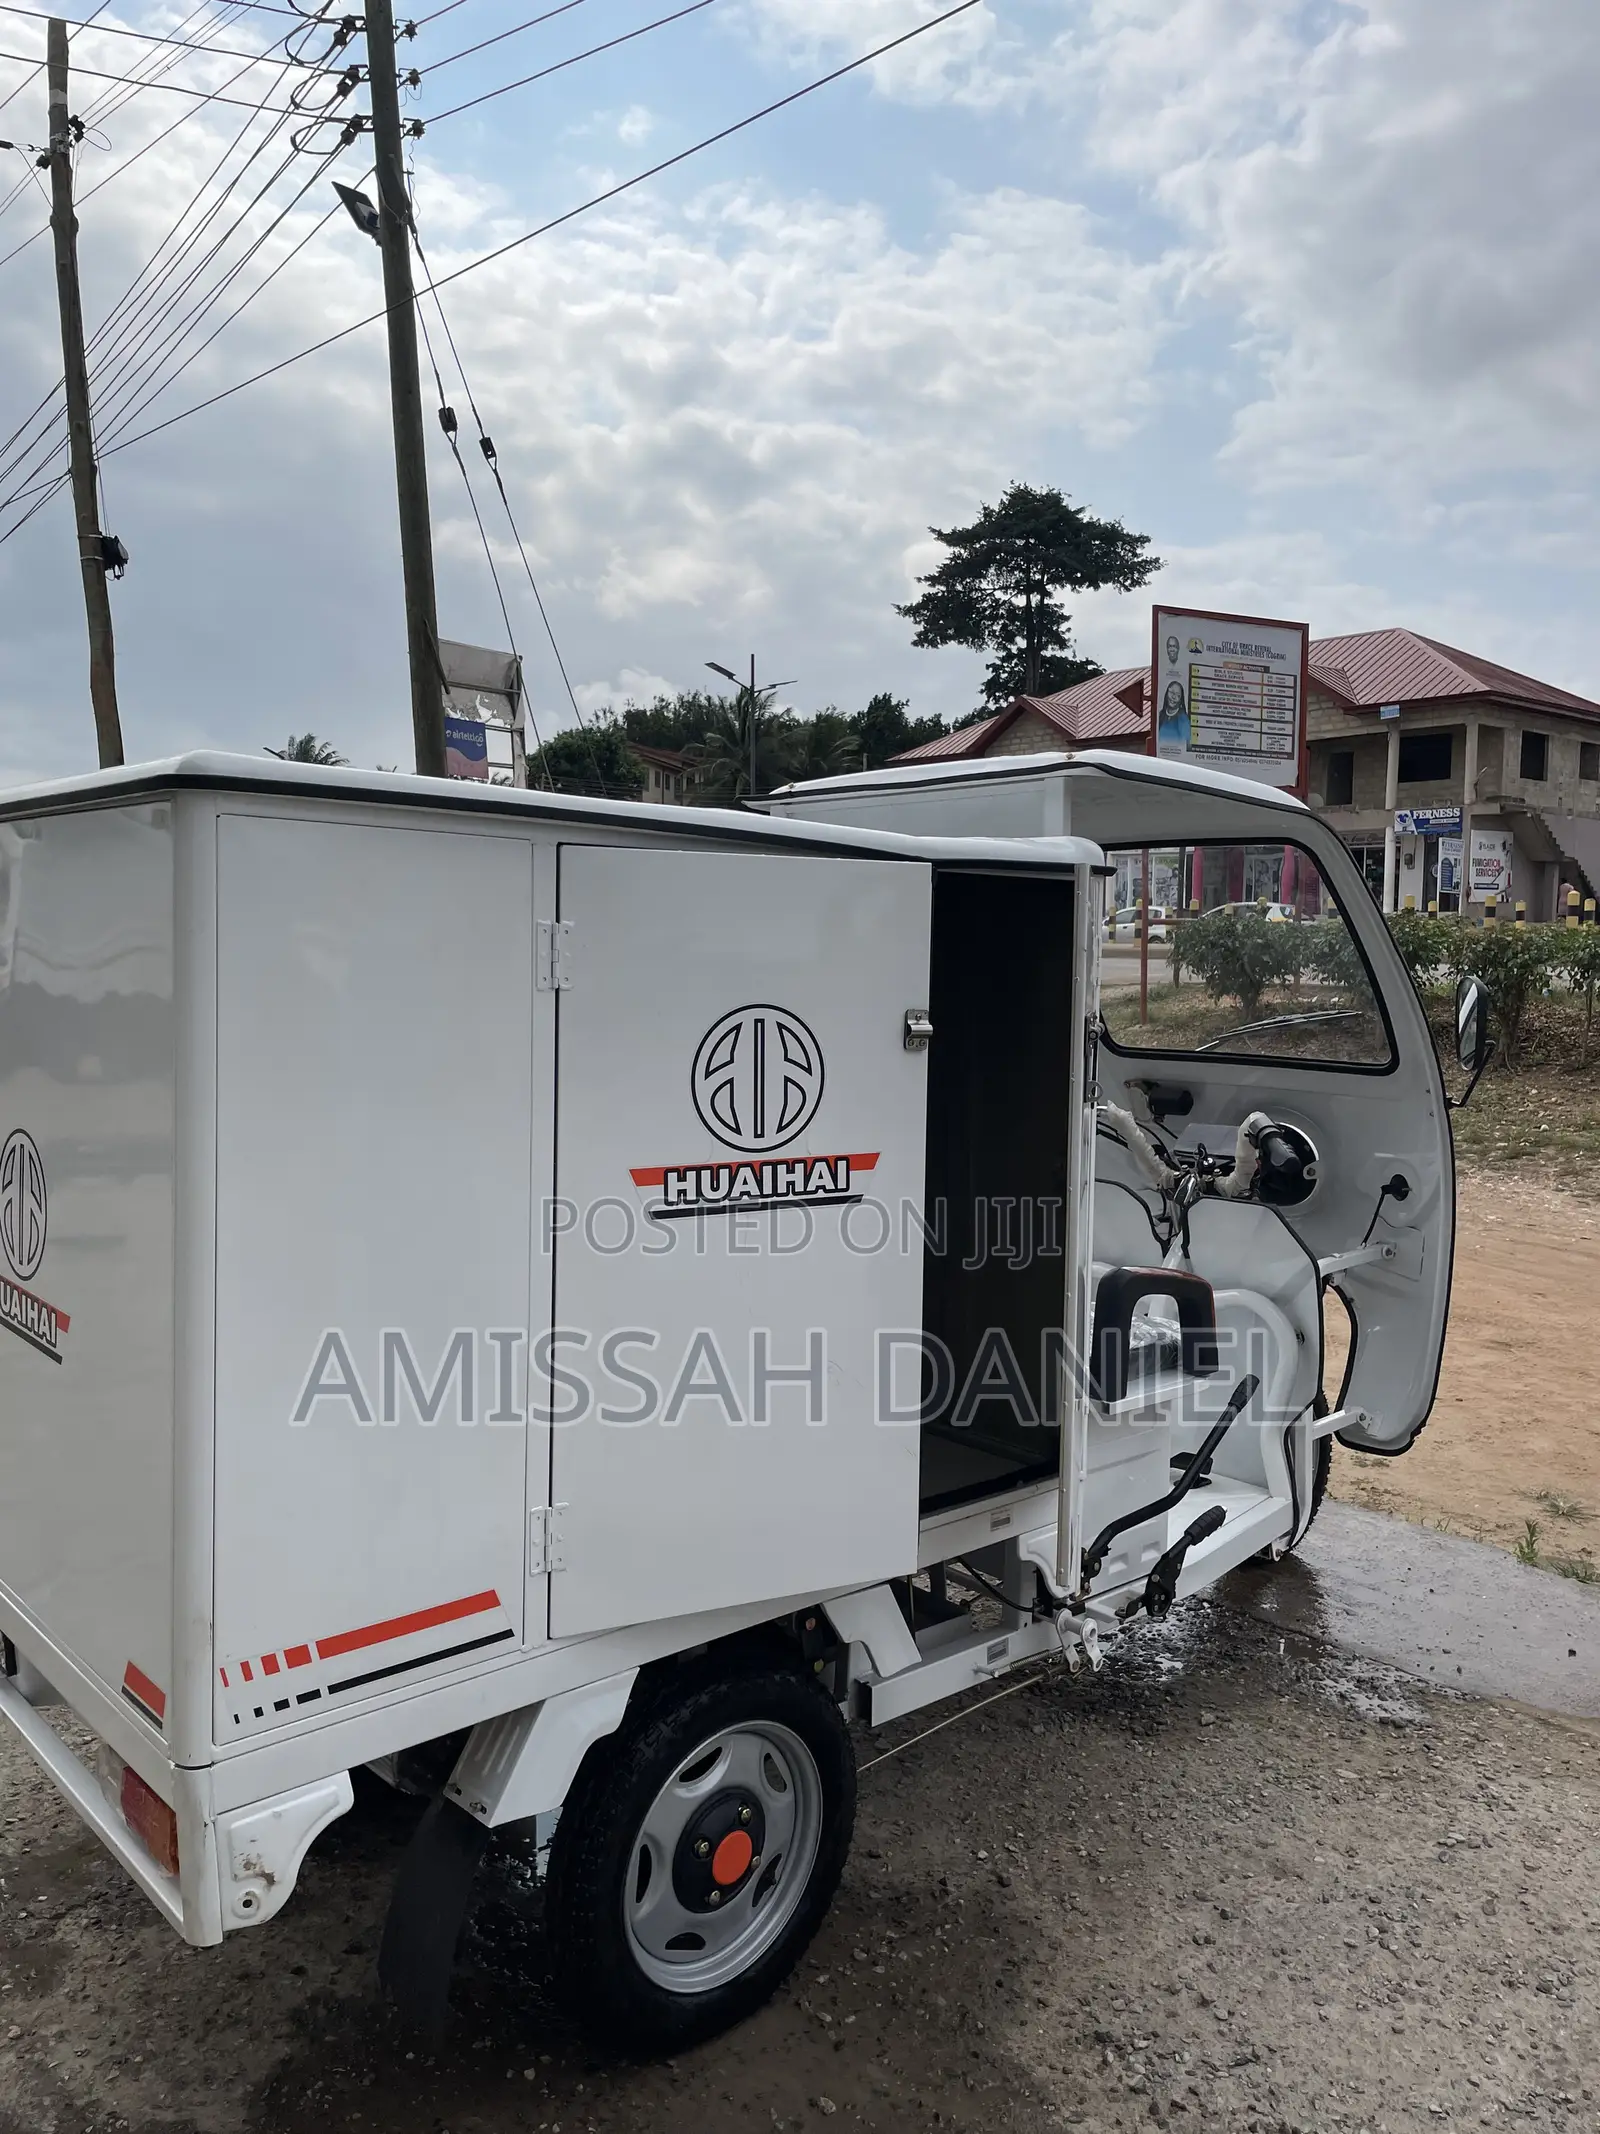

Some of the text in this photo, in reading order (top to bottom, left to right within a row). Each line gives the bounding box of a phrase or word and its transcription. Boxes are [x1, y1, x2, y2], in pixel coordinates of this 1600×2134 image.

[1206, 645, 1240, 656] INTERNATIONAL
[1240, 649, 1265, 658] MINISTRIES
[1221, 641, 1232, 649] CITY
[1413, 807, 1461, 820] FERNESS
[664, 1158, 851, 1207] HUAIHAI
